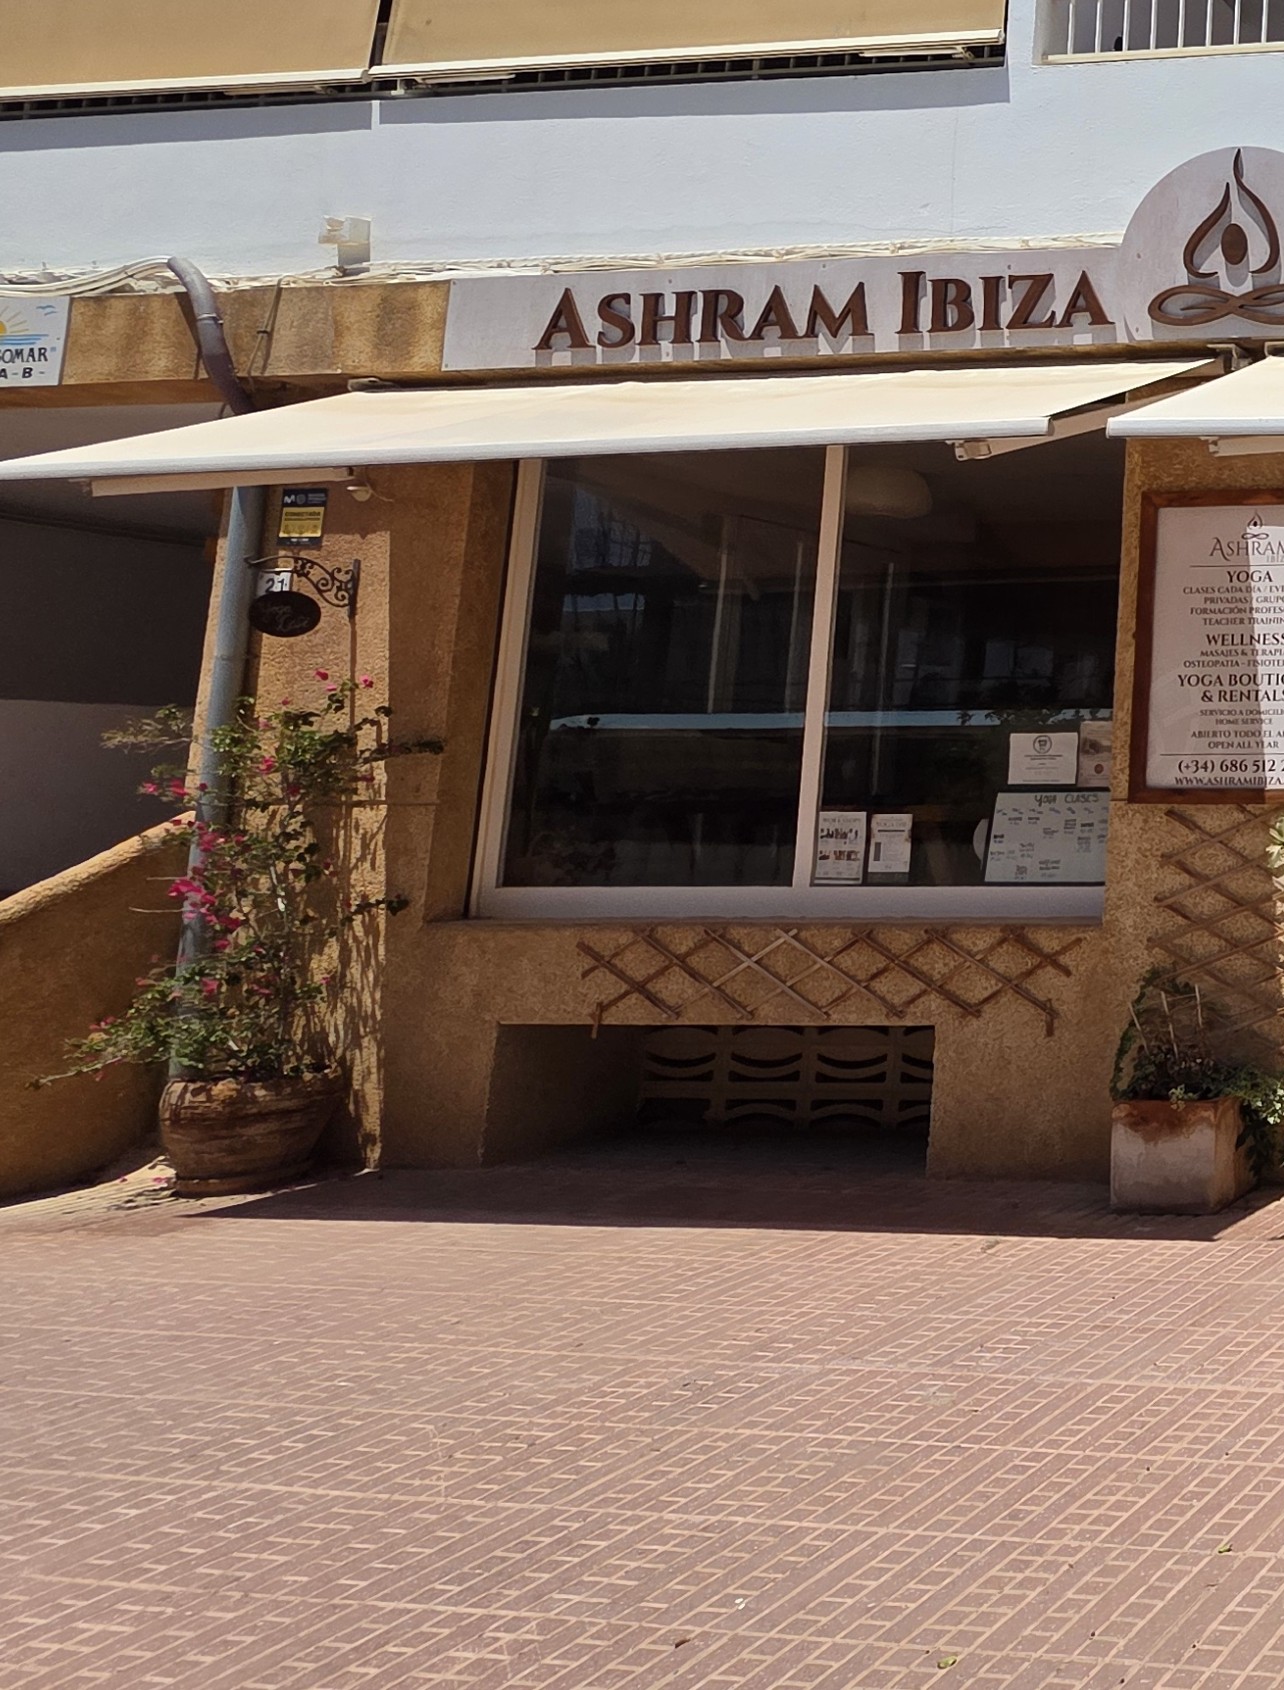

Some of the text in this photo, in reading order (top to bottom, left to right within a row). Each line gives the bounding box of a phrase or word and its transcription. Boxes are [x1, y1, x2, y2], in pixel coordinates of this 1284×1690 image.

[532, 270, 1115, 351] ASHRAM IBIZA
[1226, 570, 1274, 583] YOGA
[264, 577, 286, 593] 21
[1182, 586, 1216, 595] CLASES
[1217, 586, 1244, 594] CADA
[1203, 596, 1249, 605] PRIVADAS
[1190, 606, 1248, 616] FORMACIÓN
[1202, 617, 1245, 626] TEACHER
[1200, 649, 1239, 658] MASAJES
[1240, 649, 1248, 657] &
[1177, 674, 1226, 688] YOGA
[1200, 690, 1214, 703] &
[1199, 708, 1237, 717] SERVICIO
[1237, 708, 1245, 716] A
[1215, 717, 1273, 726] HOME SERVICE
[1191, 730, 1231, 739] ABIERTO
[1233, 729, 1262, 739] TODO
[1262, 730, 1274, 738] EL
[1207, 740, 1280, 750] OPEN ALL YEAR
[1177, 759, 1216, 774] (+34)
[1219, 759, 1249, 773] 686
[1251, 758, 1277, 773] 512
